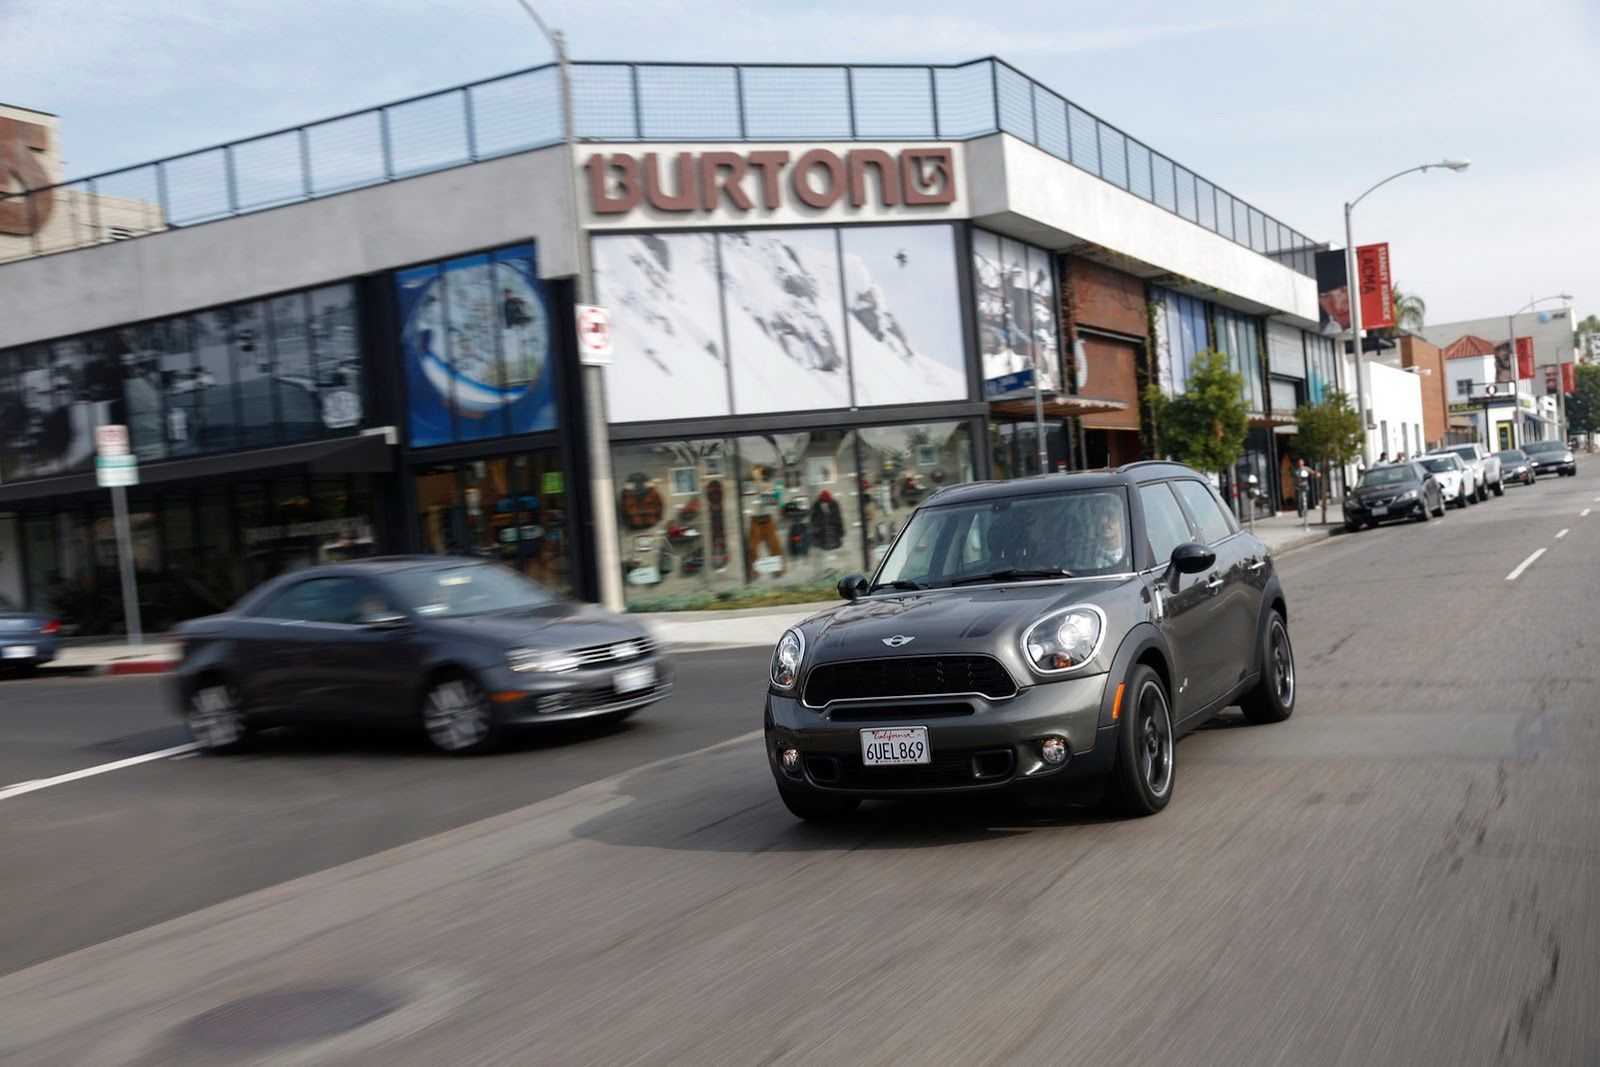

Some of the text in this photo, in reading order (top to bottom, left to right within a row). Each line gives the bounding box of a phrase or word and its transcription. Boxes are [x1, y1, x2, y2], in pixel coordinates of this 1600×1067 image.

[585, 149, 898, 213] BURTON
[1360, 248, 1376, 294] LACMA
[866, 741, 924, 760] 6UEL869
[873, 730, 913, 741] California
